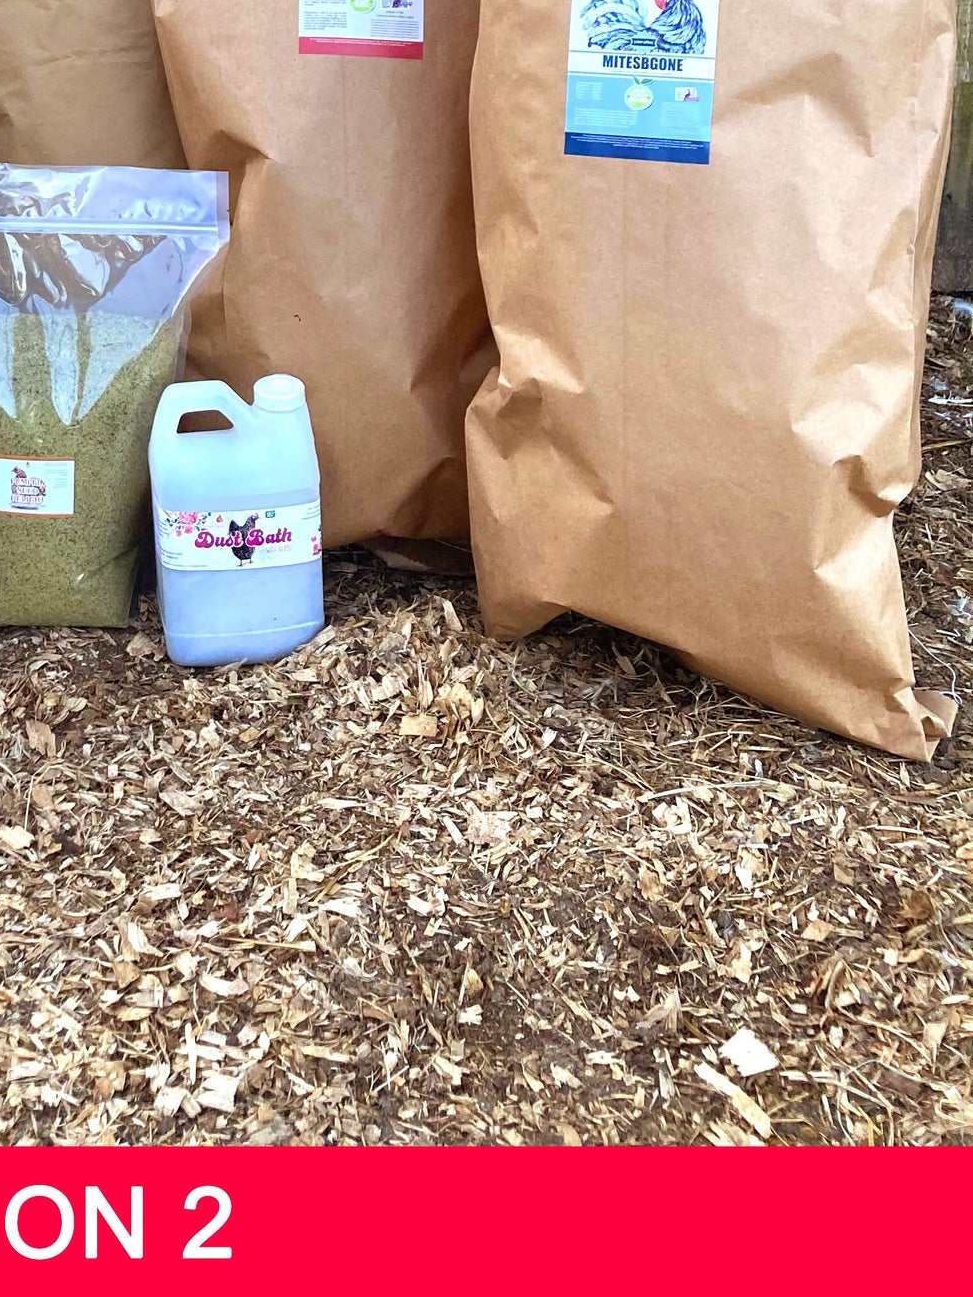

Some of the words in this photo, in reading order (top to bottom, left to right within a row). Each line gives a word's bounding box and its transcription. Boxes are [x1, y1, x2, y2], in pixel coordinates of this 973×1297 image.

[602, 54, 684, 72] MITESBGONE
[194, 531, 243, 549] Dust
[246, 527, 293, 547] Bath
